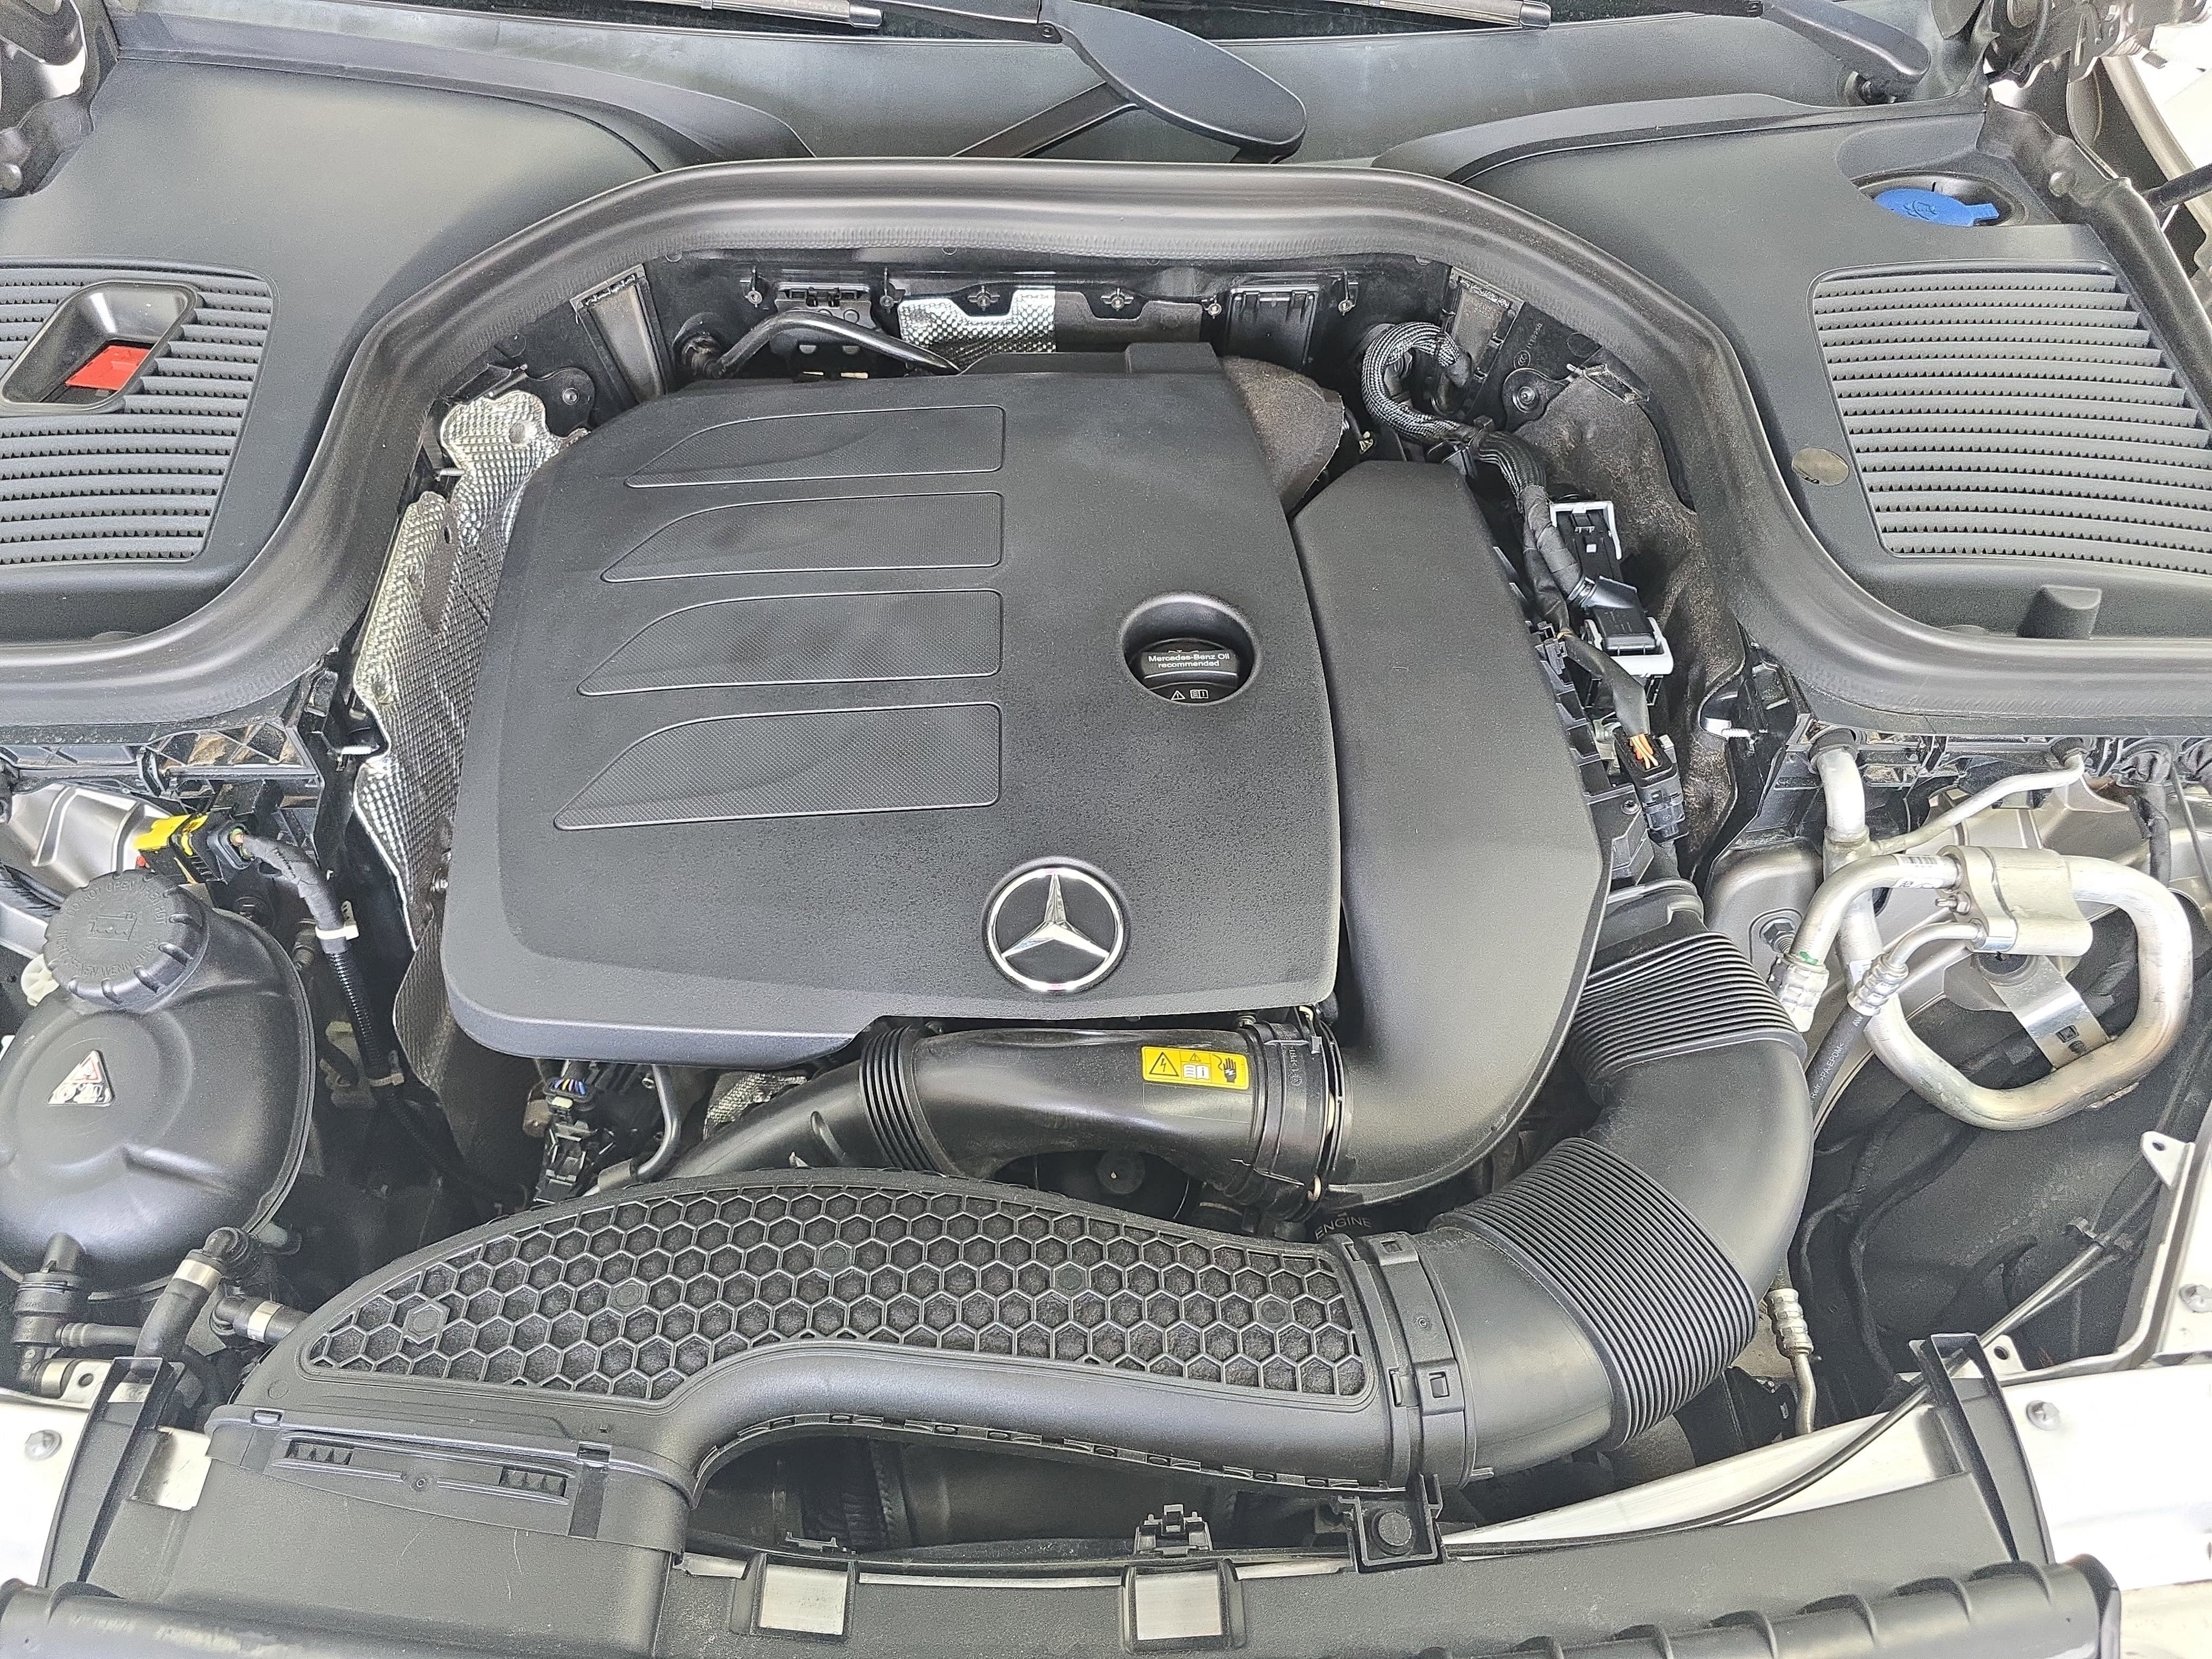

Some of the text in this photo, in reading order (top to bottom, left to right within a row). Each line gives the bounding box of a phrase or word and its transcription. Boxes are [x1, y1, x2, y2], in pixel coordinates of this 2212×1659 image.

[1148, 654, 1216, 663] Mercedes-Benz
[1158, 660, 1220, 668] recommended
[1314, 1216, 1372, 1241] ENGINE
